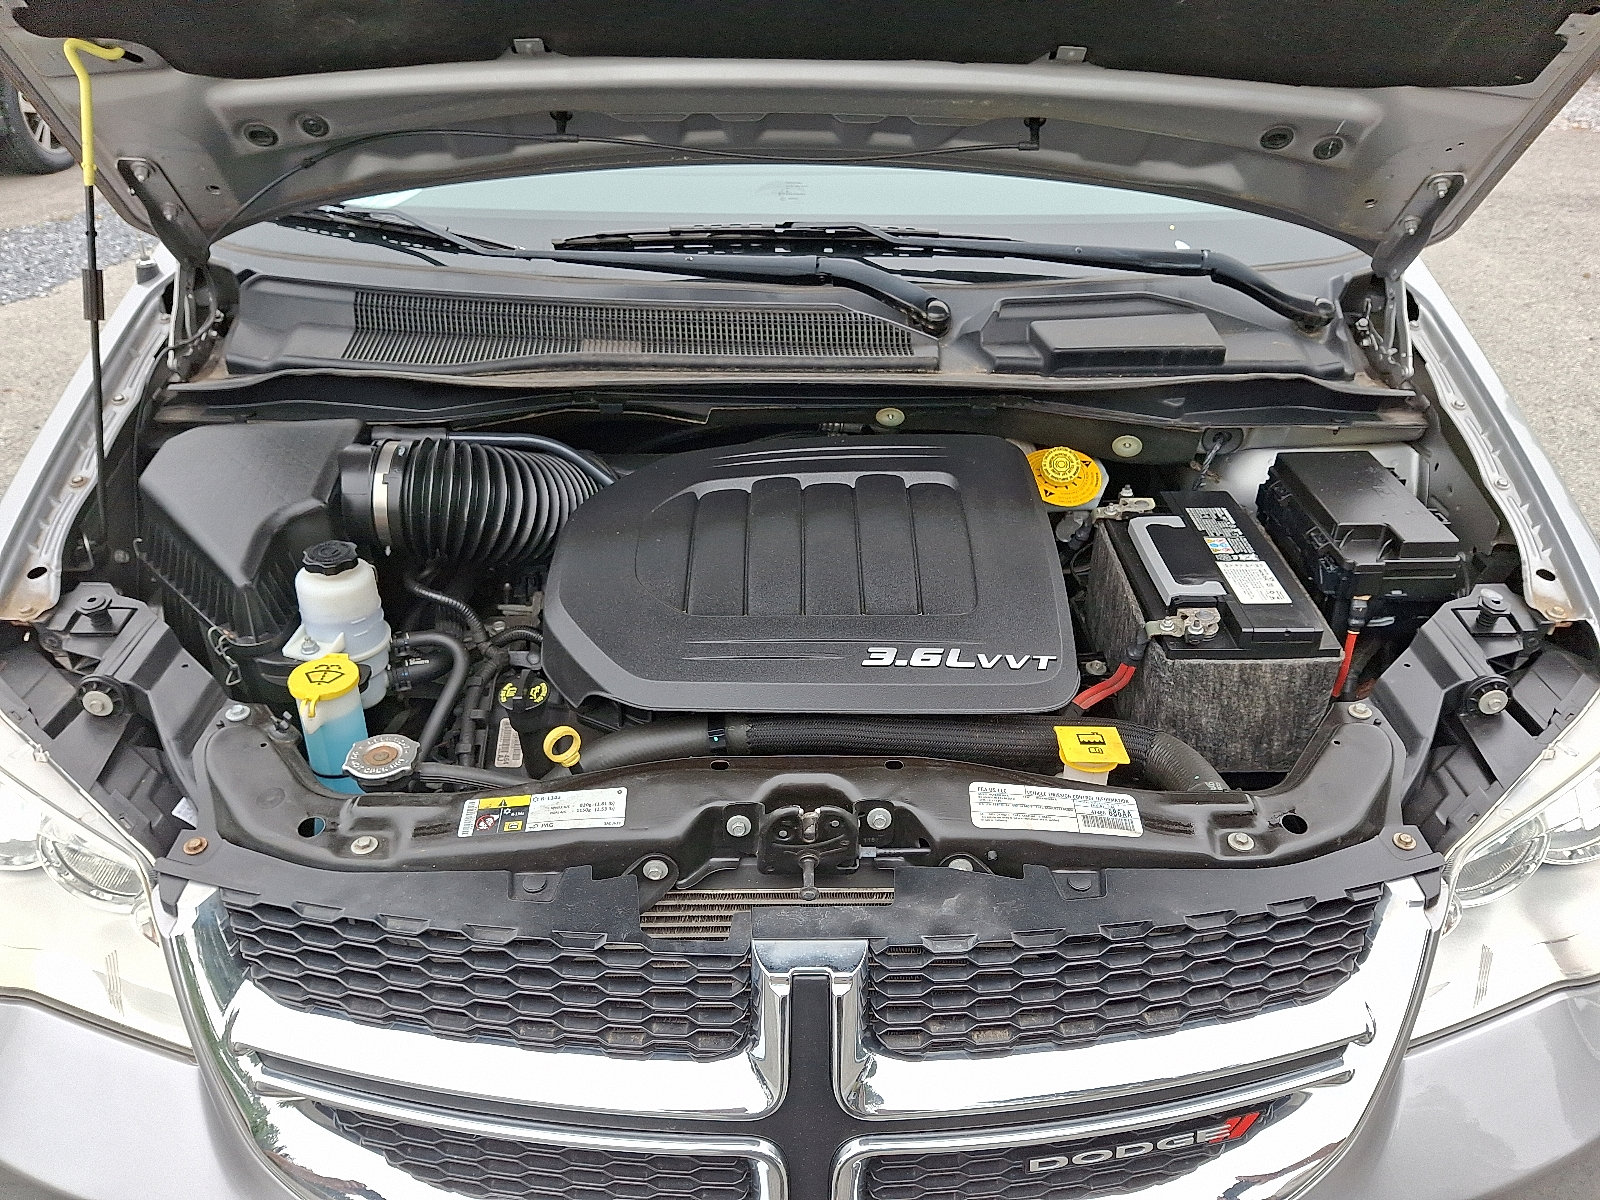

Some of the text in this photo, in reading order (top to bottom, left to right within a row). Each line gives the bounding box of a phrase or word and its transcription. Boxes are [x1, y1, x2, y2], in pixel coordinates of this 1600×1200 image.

[861, 647, 1057, 670] 3.6L VVT
[1029, 1124, 1232, 1172] DODGE
